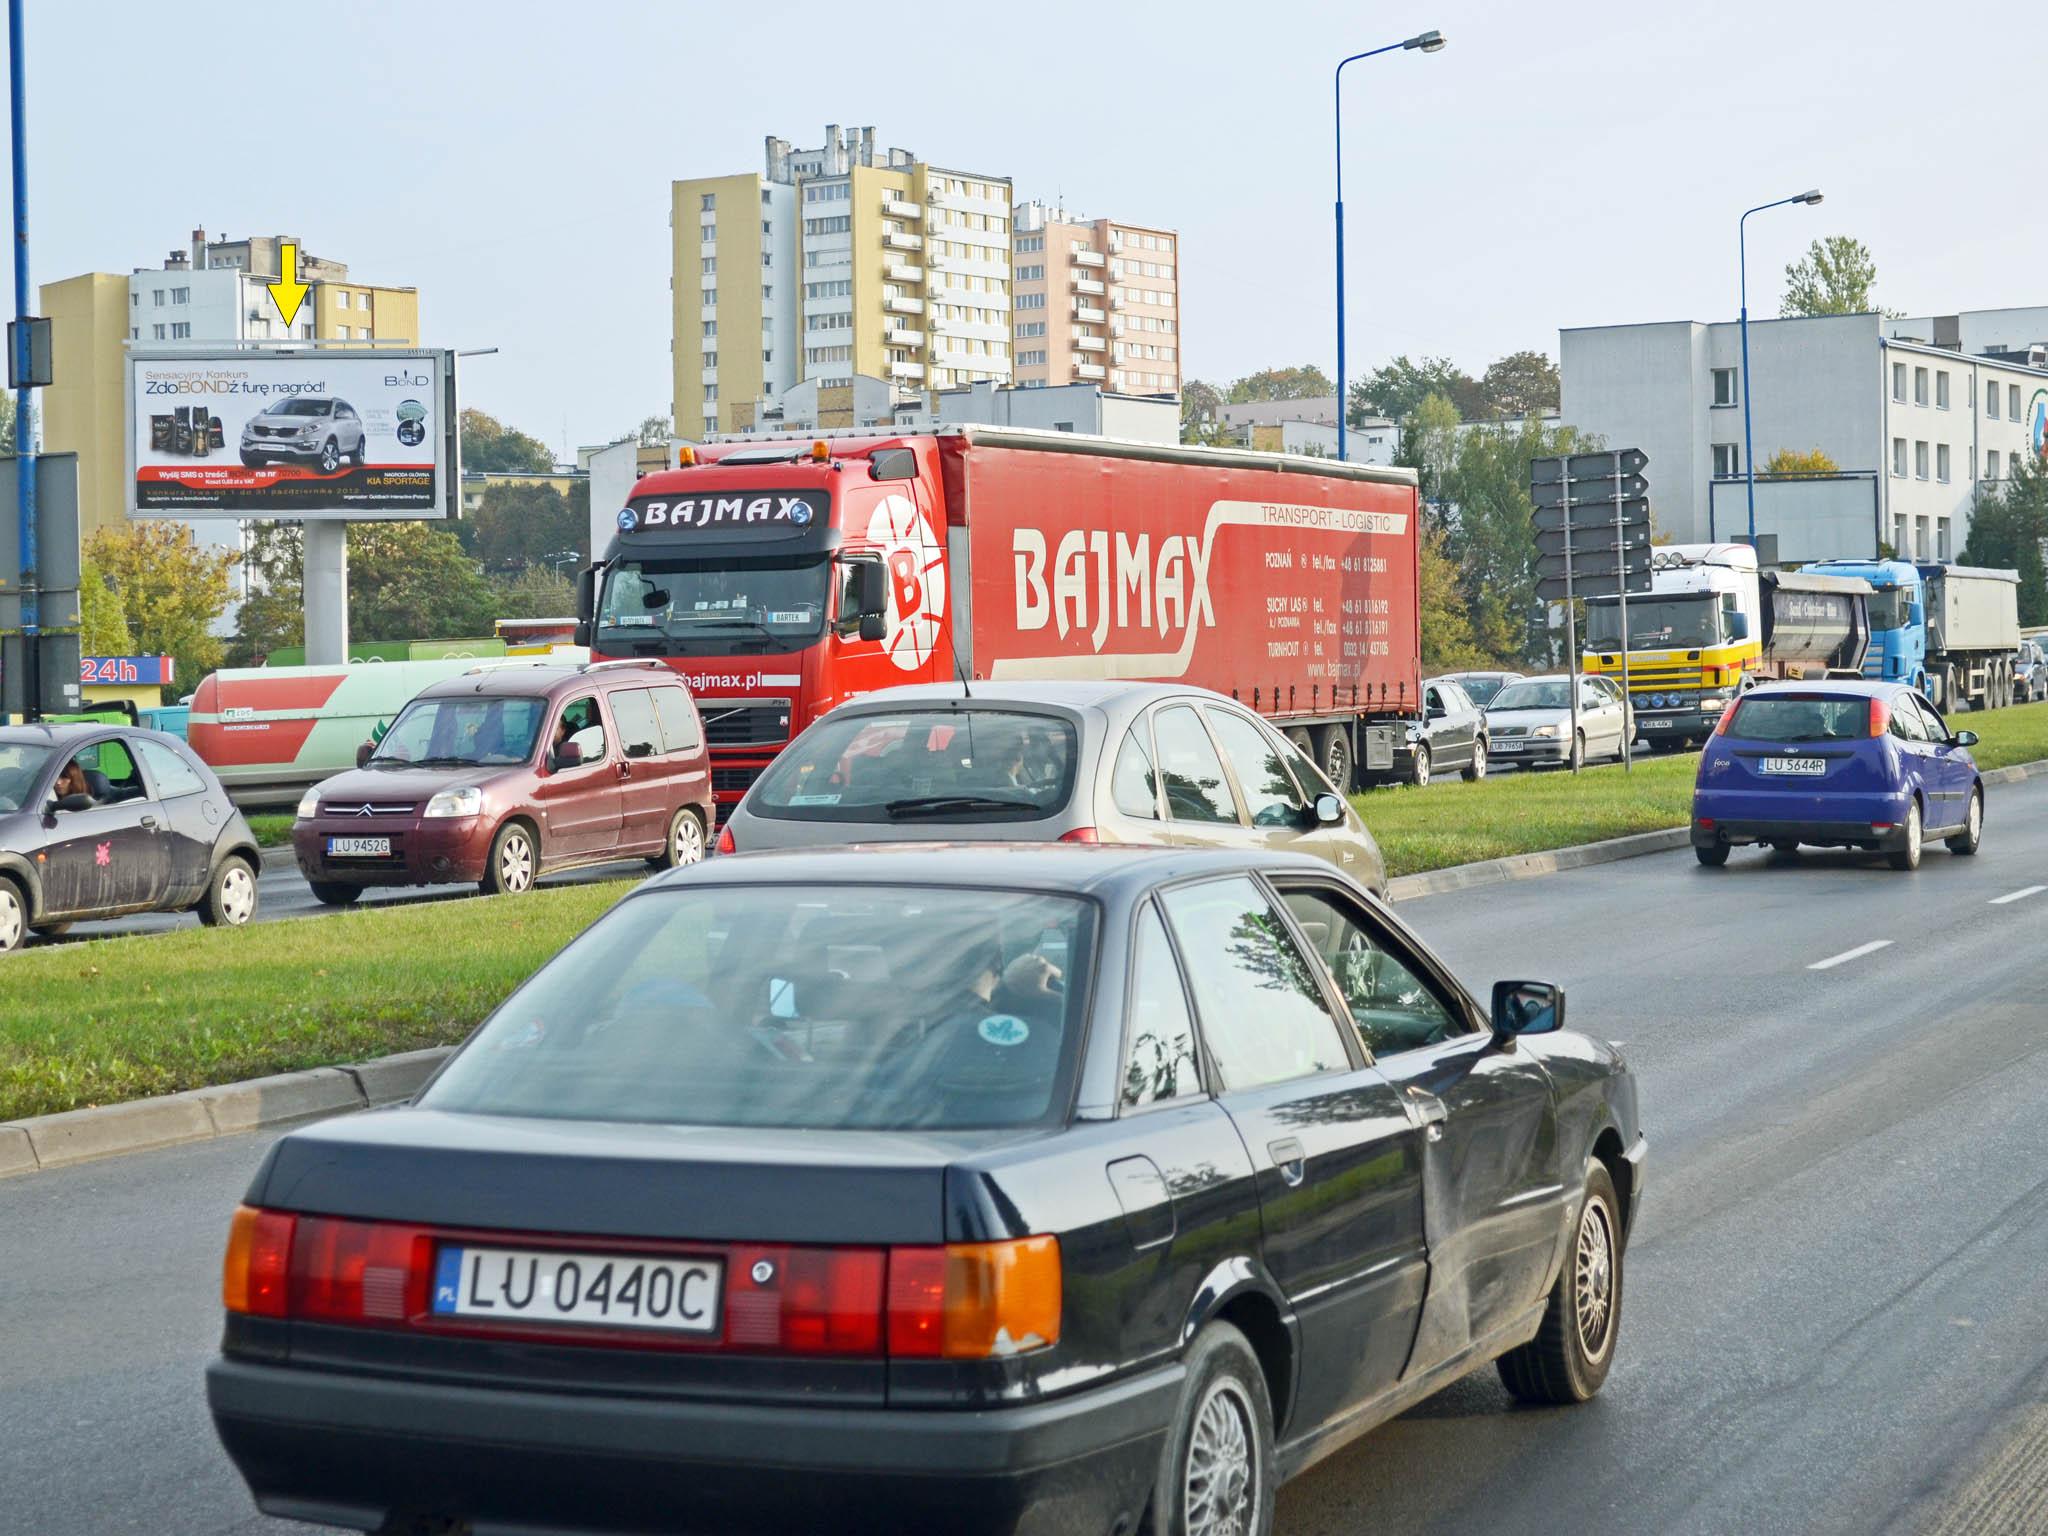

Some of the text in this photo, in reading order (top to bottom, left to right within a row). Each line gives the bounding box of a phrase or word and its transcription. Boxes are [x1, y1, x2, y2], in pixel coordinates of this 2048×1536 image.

[145, 370, 248, 381] Sensacyjny Konkurs
[146, 380, 326, 396] ZdoBONDź furę nagród!
[159, 471, 180, 479] Wyślij
[205, 470, 228, 478] treści
[367, 477, 430, 485] KIA SPORTAGE
[645, 497, 800, 527] BAJMAX
[1261, 506, 1333, 527] TRANSPORT
[1341, 514, 1391, 532] LOGISTIC
[1265, 548, 1292, 569] POZNAŃ
[1354, 557, 1361, 572] 61
[1013, 528, 1216, 654] BAJMAX
[1266, 597, 1288, 613] SUCHY
[1290, 597, 1302, 613] LAS
[1355, 600, 1362, 614] 61
[776, 613, 800, 622] BARTEK
[1355, 621, 1362, 635] 61
[1267, 641, 1299, 657] TURNHOUT
[80, 659, 137, 682] 24h
[1766, 759, 1824, 772] LU 5644R
[335, 839, 388, 852] LU 9452G
[469, 1255, 538, 1310] LU
[554, 1260, 708, 1321] 0440C
